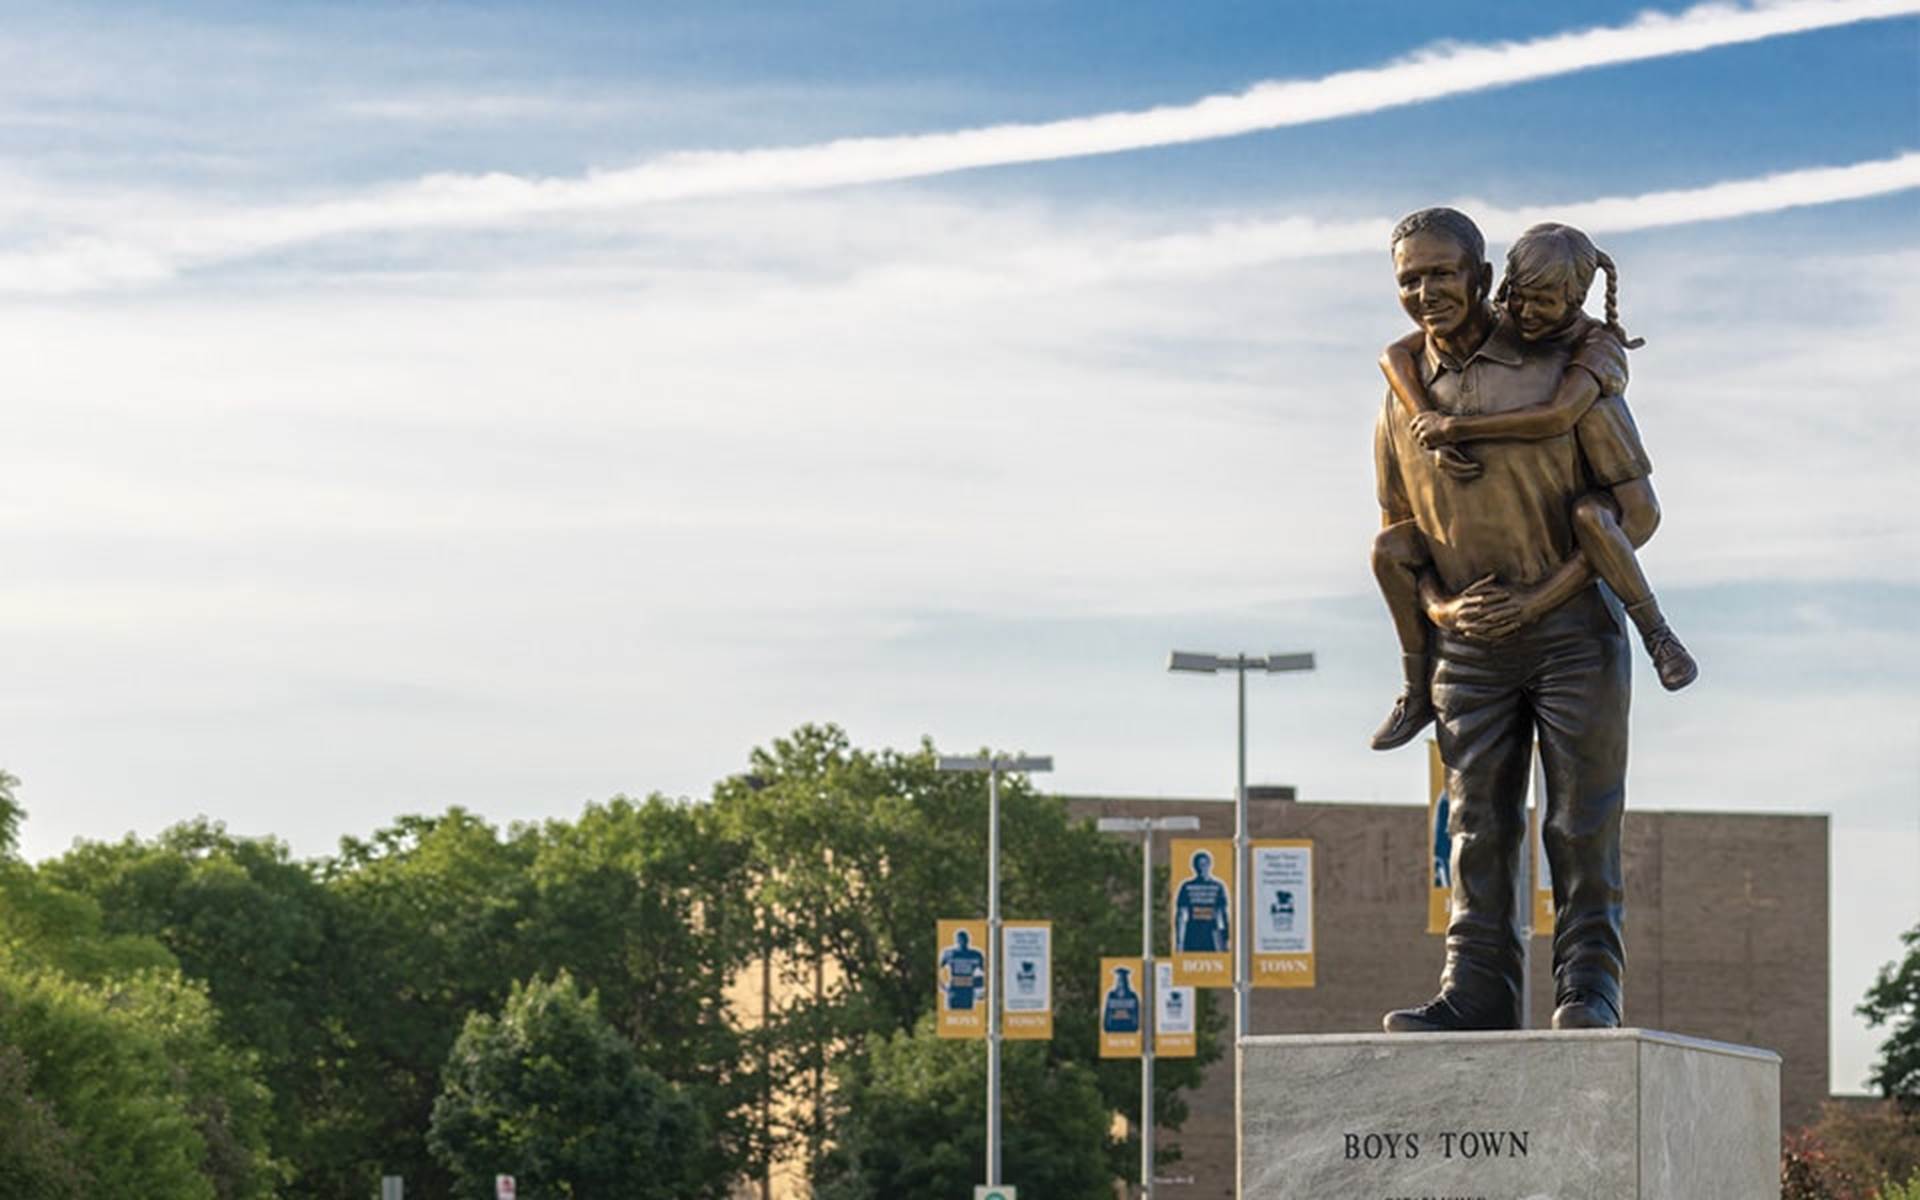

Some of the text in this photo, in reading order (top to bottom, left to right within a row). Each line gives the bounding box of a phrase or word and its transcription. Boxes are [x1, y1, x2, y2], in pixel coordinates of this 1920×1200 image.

[1182, 960, 1224, 973] BOYS
[1259, 960, 1308, 973] TOWN
[1344, 1131, 1529, 1160] BOYS TOWN
